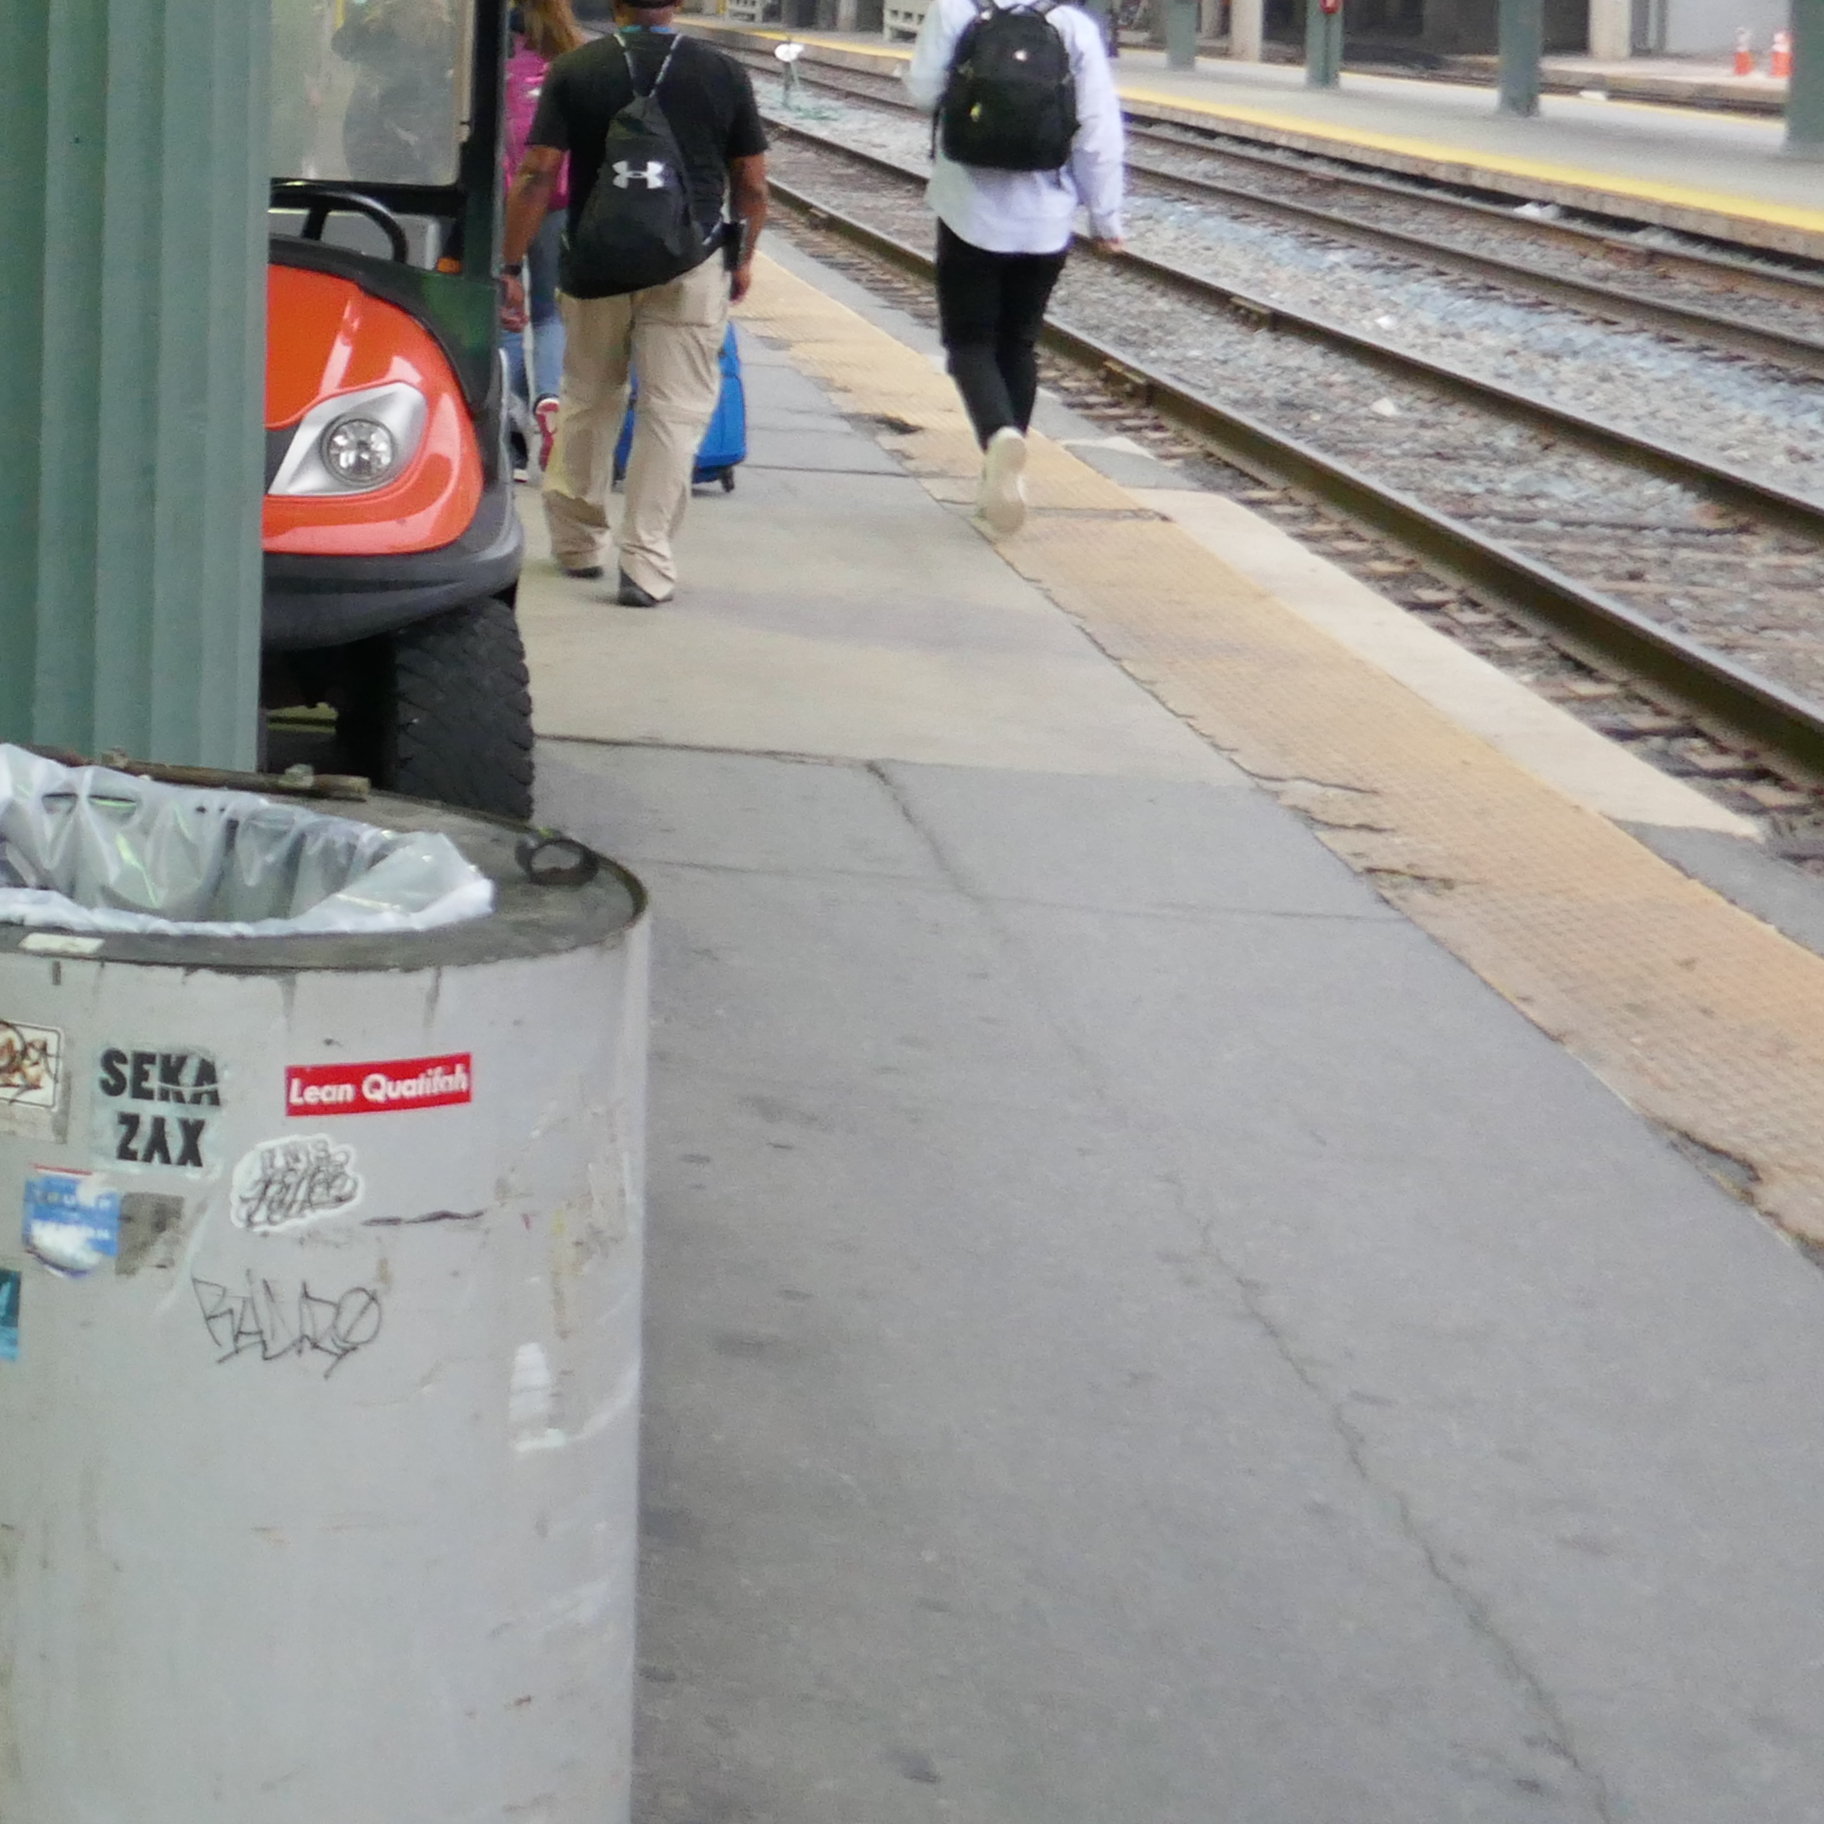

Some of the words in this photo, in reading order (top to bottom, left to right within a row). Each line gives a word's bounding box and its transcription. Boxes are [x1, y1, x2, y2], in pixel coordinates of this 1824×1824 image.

[99, 1048, 220, 1107] SEKA
[289, 1077, 355, 1104] Lean
[116, 1111, 206, 1167] ZAX
